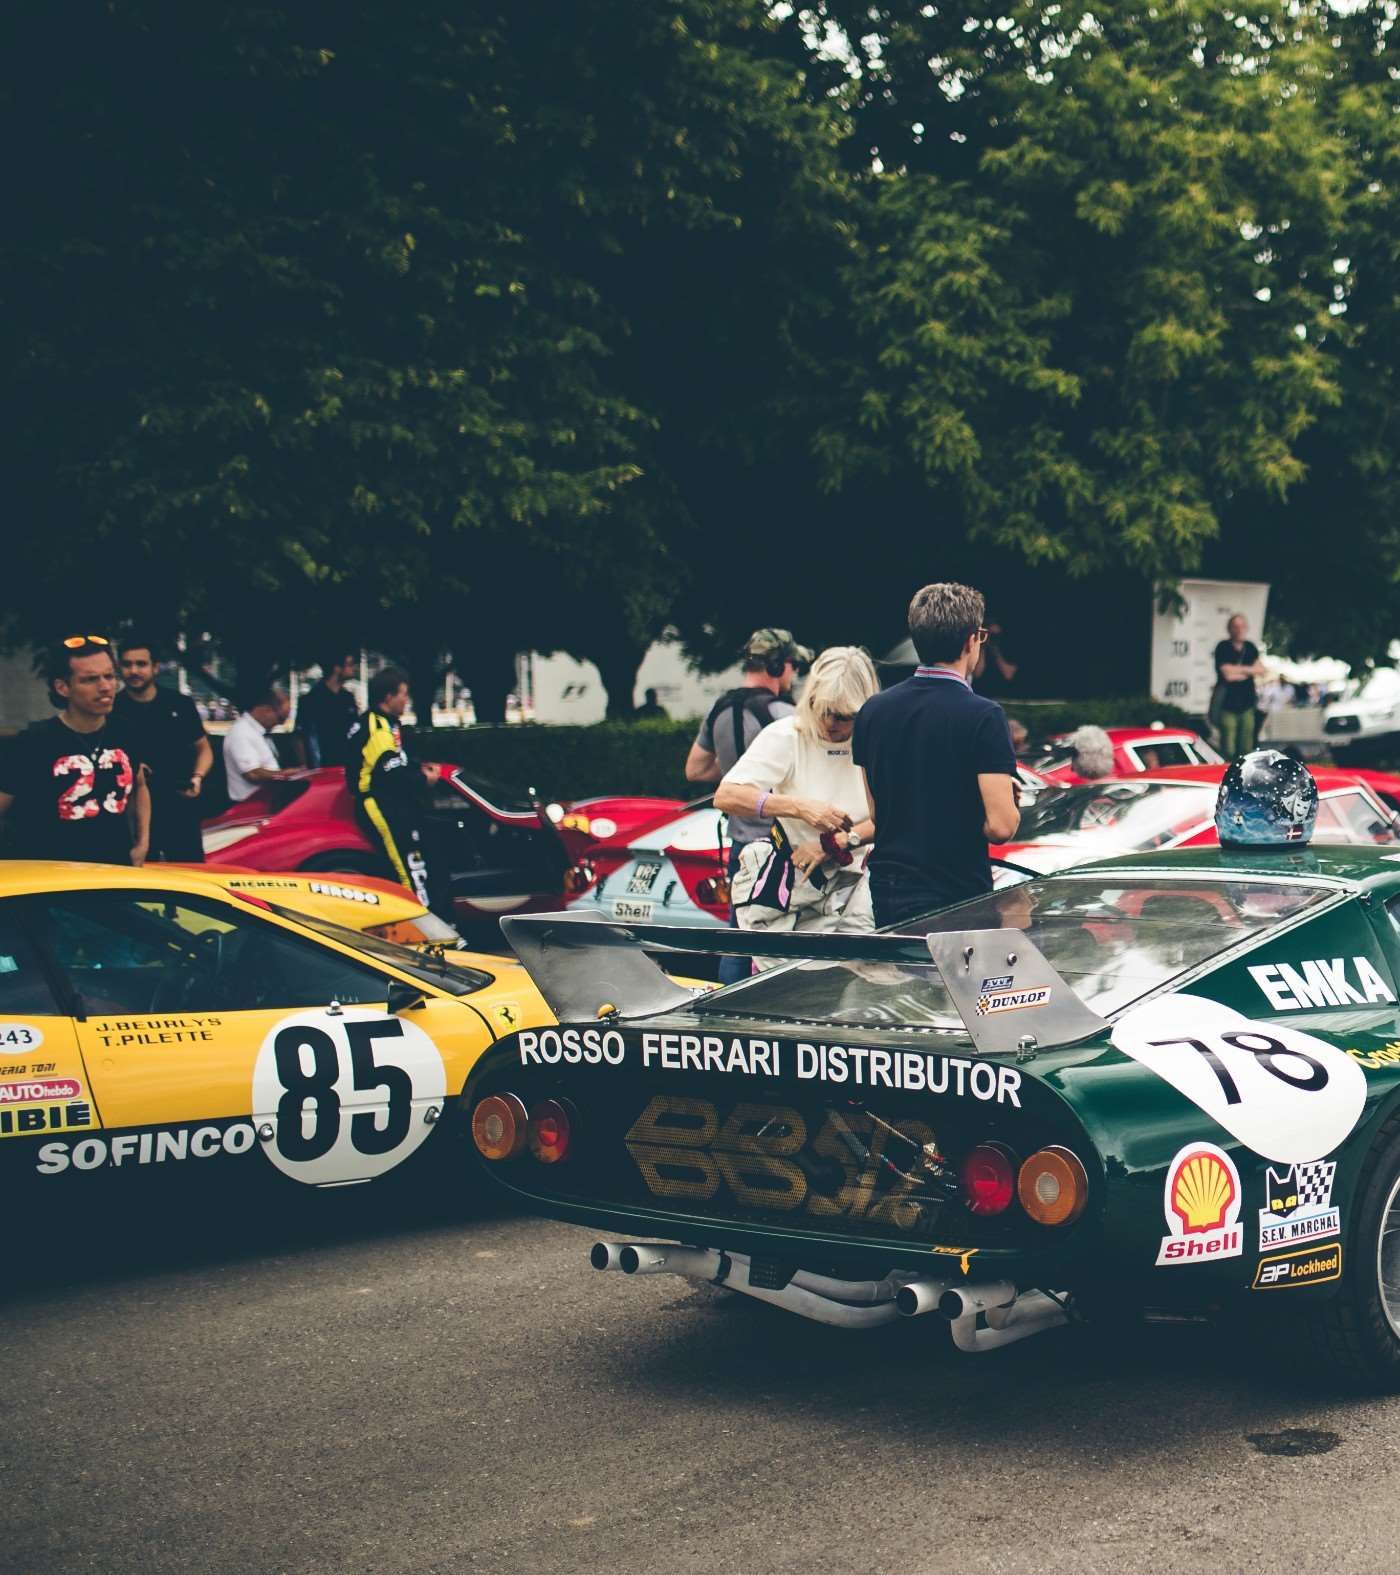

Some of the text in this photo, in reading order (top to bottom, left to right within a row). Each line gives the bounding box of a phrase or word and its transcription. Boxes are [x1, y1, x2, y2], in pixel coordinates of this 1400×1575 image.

[53, 748, 132, 820] 23
[311, 883, 379, 904] FERODO
[615, 902, 651, 917] Shell
[1246, 956, 1398, 1011] EMKA
[991, 991, 1046, 1008] DUNLOP
[96, 1018, 222, 1032] J.BEURLYS
[100, 1030, 214, 1047] T.PILETTE
[0, 1065, 26, 1076] ERIA
[519, 1030, 1022, 1108] ROSSO FERRARI DISTRIBUTOR
[1146, 1031, 1330, 1105] 78
[274, 1019, 412, 1162] 85
[0, 1101, 91, 1134] IBIÉ
[36, 1124, 256, 1175] SOFINCO
[1261, 1213, 1339, 1243] S.E.V. MARCHAL
[1165, 1231, 1237, 1259] Shell
[1290, 1254, 1338, 1278] Lockheed
